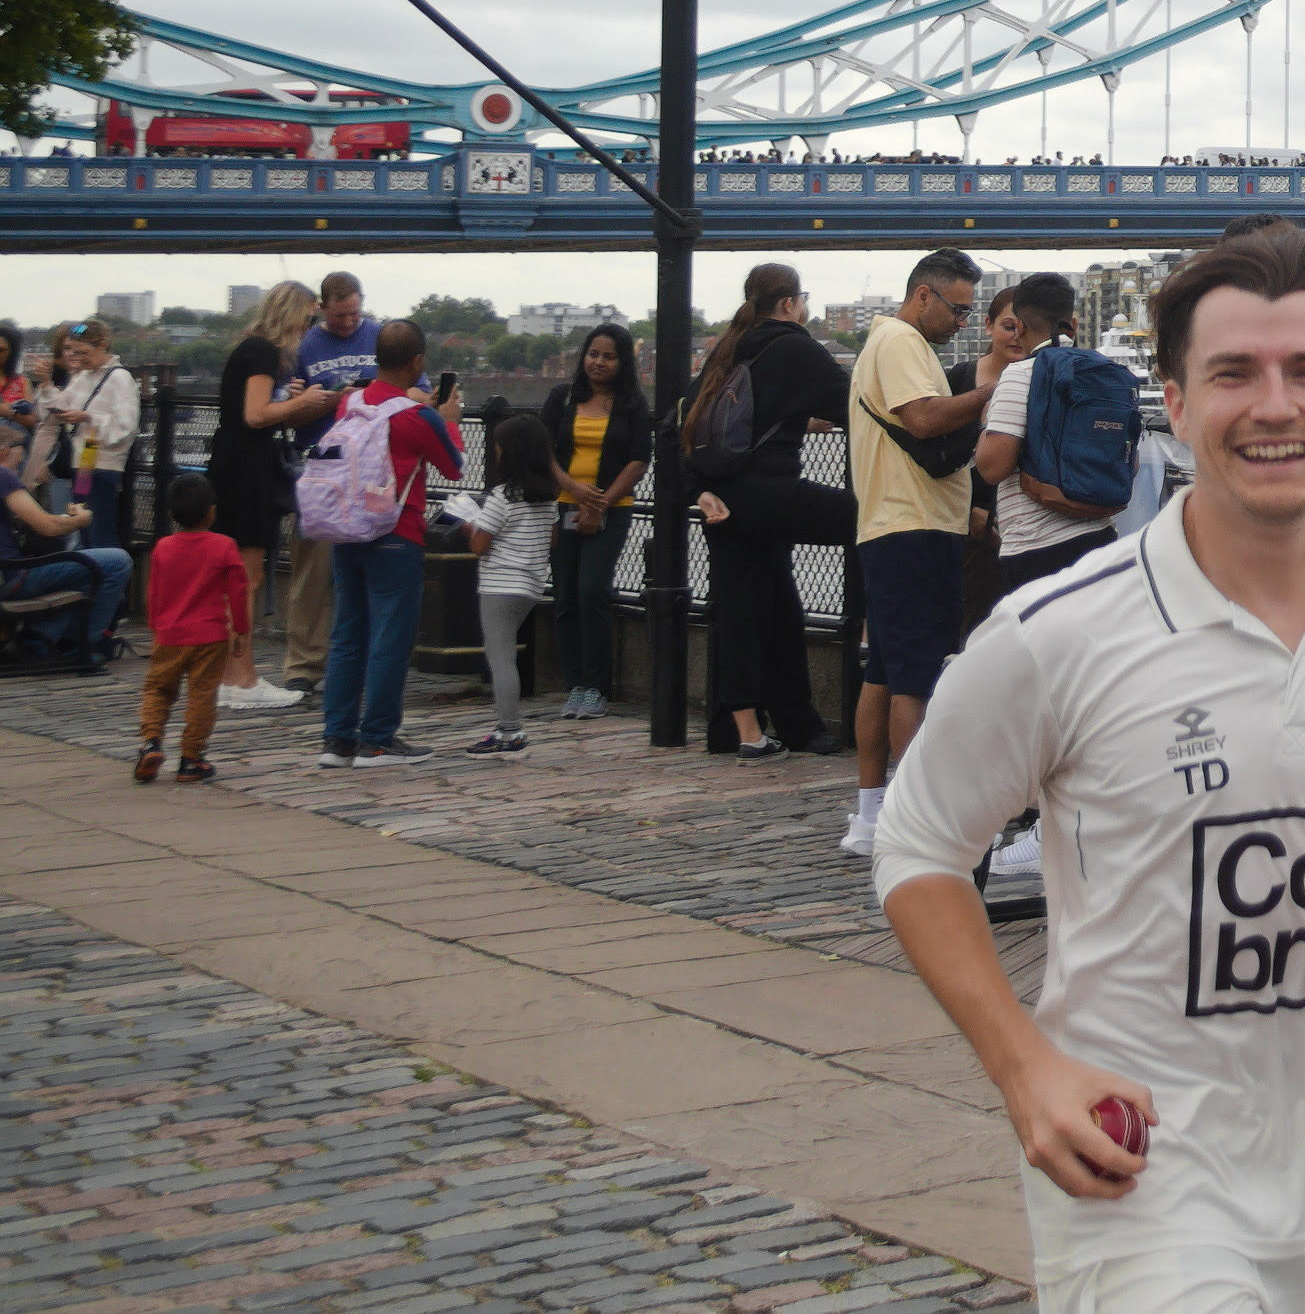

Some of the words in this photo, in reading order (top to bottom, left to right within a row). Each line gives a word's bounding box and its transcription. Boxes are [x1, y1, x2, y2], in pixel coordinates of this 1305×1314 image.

[307, 354, 377, 376] KENTUCK
[1166, 735, 1226, 760] SHREY
[1173, 758, 1230, 795] TD
